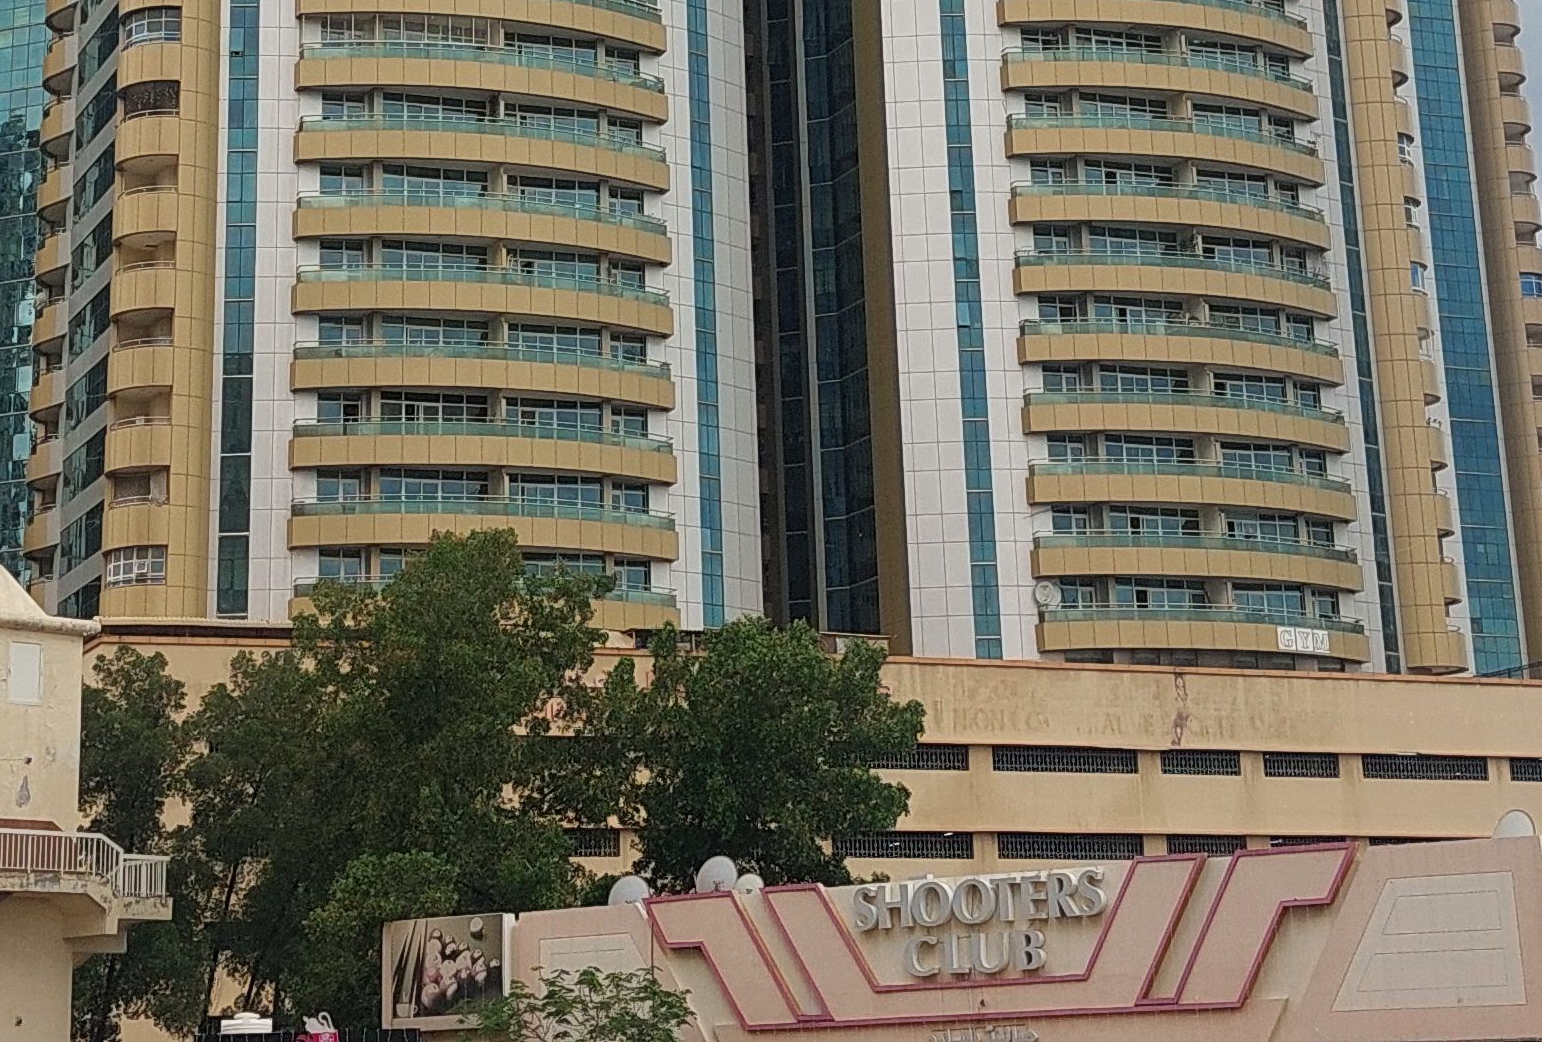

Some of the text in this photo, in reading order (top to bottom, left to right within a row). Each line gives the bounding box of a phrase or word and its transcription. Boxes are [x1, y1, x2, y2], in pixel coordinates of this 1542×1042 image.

[1279, 629, 1330, 652] GYM
[853, 866, 1108, 932] SHOOTERS
[905, 930, 1048, 978] CLUB
